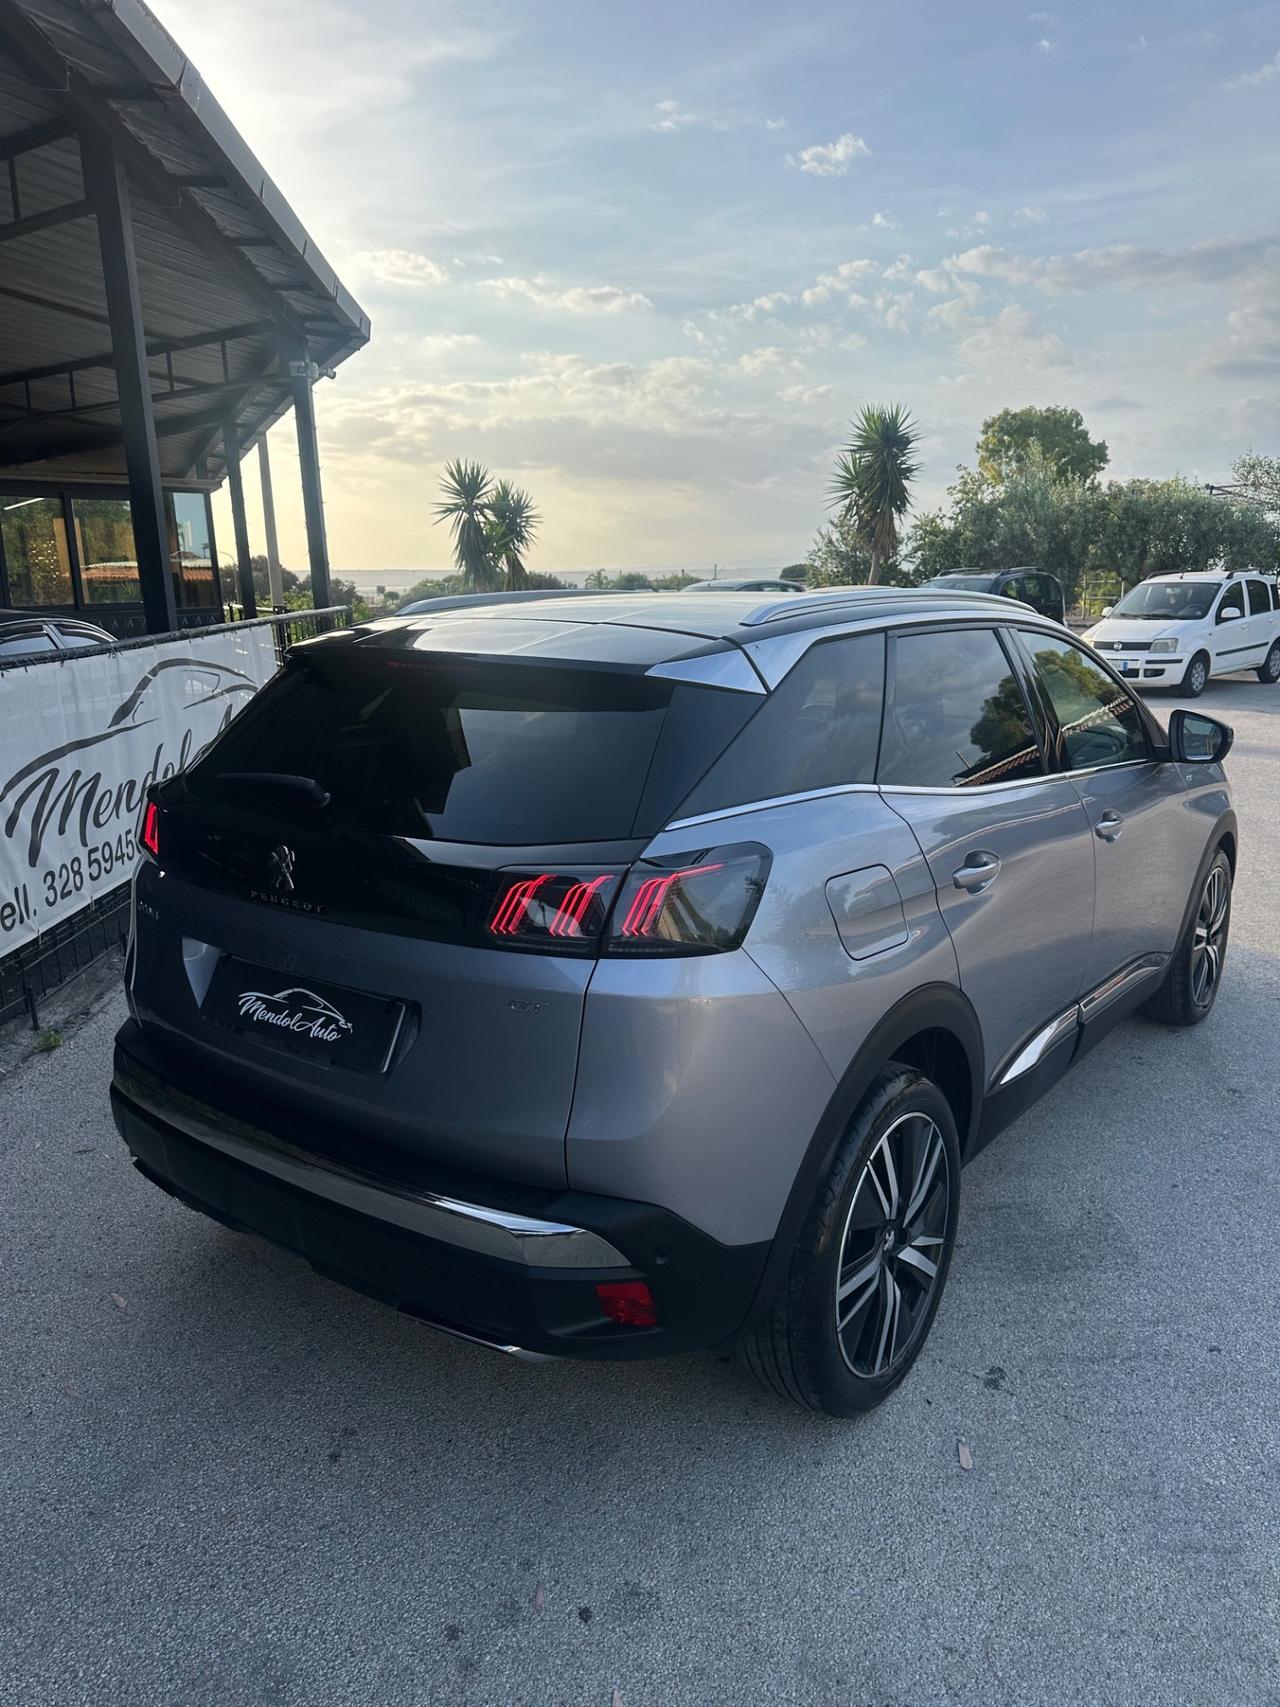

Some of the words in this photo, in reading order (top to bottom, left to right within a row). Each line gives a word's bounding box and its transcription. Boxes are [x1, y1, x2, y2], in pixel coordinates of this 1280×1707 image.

[0, 884, 37, 932] ell.
[43, 856, 84, 907] 328
[87, 829, 136, 882] 5945
[249, 889, 324, 913] PEUGEOT
